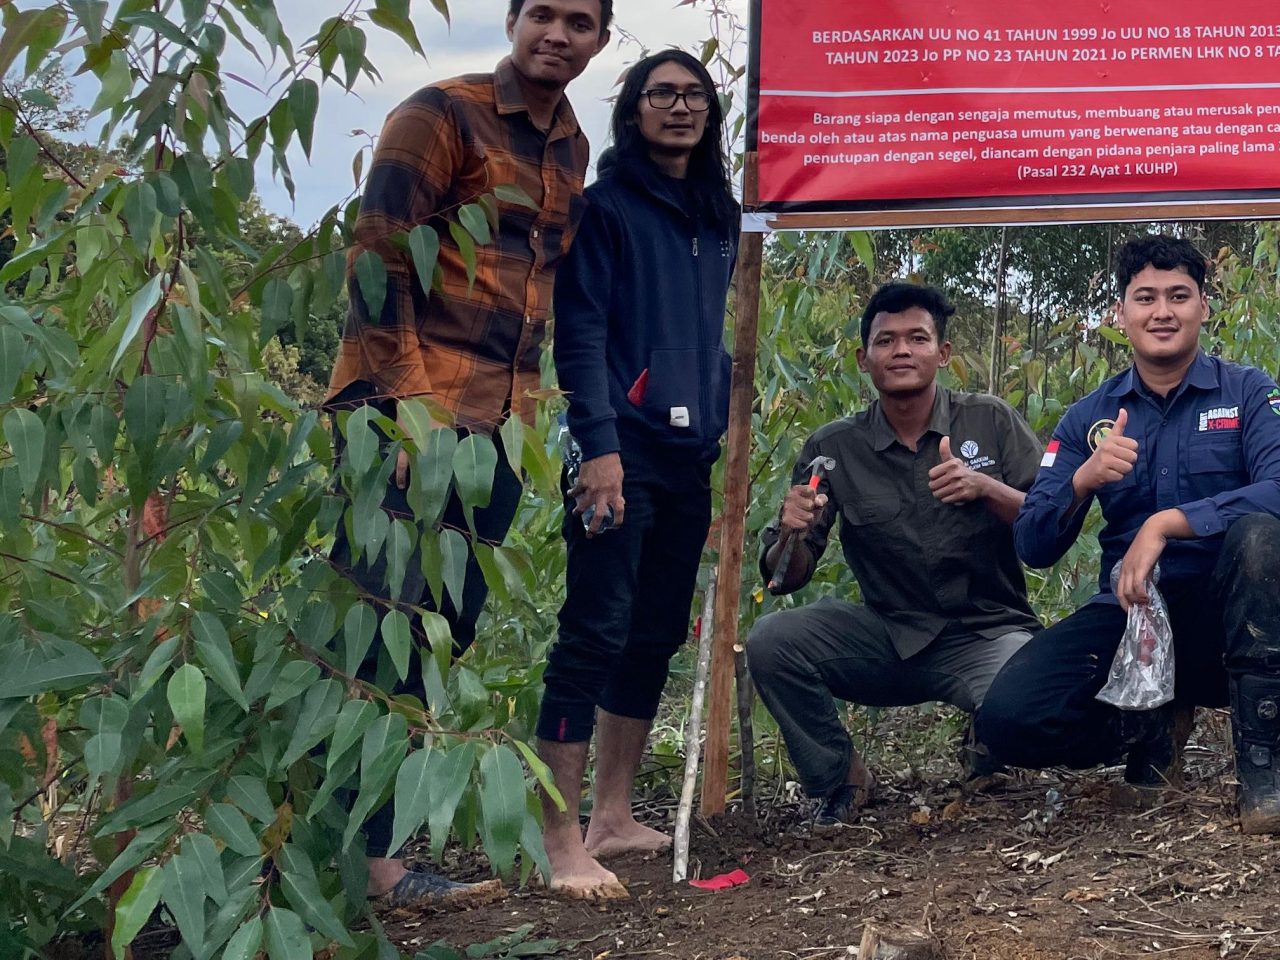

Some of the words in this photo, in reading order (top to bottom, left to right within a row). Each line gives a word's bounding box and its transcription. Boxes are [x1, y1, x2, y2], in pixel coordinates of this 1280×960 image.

[812, 27, 924, 43] BERDASARKAN
[928, 27, 952, 40] UU
[955, 28, 980, 40] NO
[983, 29, 1001, 41] 41
[1005, 28, 1058, 41] TAHUN
[1062, 27, 1098, 40] 1999
[1100, 27, 1117, 39] Jo
[1120, 27, 1143, 39] UU
[1147, 26, 1170, 38] NO
[1174, 26, 1192, 38] 18
[1194, 25, 1246, 37] TAHUN
[825, 50, 879, 64] TAHUN
[883, 48, 919, 62] 2023
[922, 48, 939, 61] Jo
[943, 48, 962, 60] PP
[966, 49, 990, 61] NO
[993, 49, 1012, 61] 23
[1015, 49, 1068, 61] TAHUN
[1072, 48, 1108, 61] 2021
[1110, 48, 1127, 60] Jo
[1130, 46, 1193, 59] PERMEN
[1197, 46, 1225, 58] LHK
[1228, 45, 1251, 57] NO
[1254, 45, 1264, 57] 8
[813, 112, 862, 126] Barang
[864, 111, 901, 125] siapa
[904, 110, 955, 124] dengan
[957, 107, 1010, 122] sengaja
[1013, 108, 1082, 120] memutus,
[1085, 105, 1161, 119] membuang
[1163, 105, 1193, 116] atau
[1196, 102, 1253, 115] merusak
[761, 130, 806, 143] benda
[809, 131, 840, 143] oleh
[843, 132, 875, 143] atau
[878, 131, 907, 142] atas
[910, 131, 949, 141] nama
[952, 129, 1018, 142] penguasa
[1021, 128, 1066, 138] umum
[1068, 128, 1102, 139] yang
[1104, 124, 1179, 137] berwenang
[1182, 124, 1212, 134] atau
[1214, 122, 1264, 136] dengan
[803, 152, 880, 165] penutupan
[883, 149, 935, 163] dengan
[938, 147, 978, 162] segel,
[980, 146, 1039, 159] diancam
[1042, 145, 1093, 159] dengan
[1096, 143, 1142, 158] pidana
[1145, 142, 1196, 157] penjara
[1199, 141, 1240, 156] paling
[1242, 140, 1275, 152] lama
[1017, 164, 1058, 180] (Pasal
[1061, 164, 1086, 176] 232
[1089, 163, 1121, 178] Ayat
[1124, 162, 1132, 174] 1
[1135, 160, 1178, 176] KUHP)
[1207, 406, 1238, 420] AGAINST
